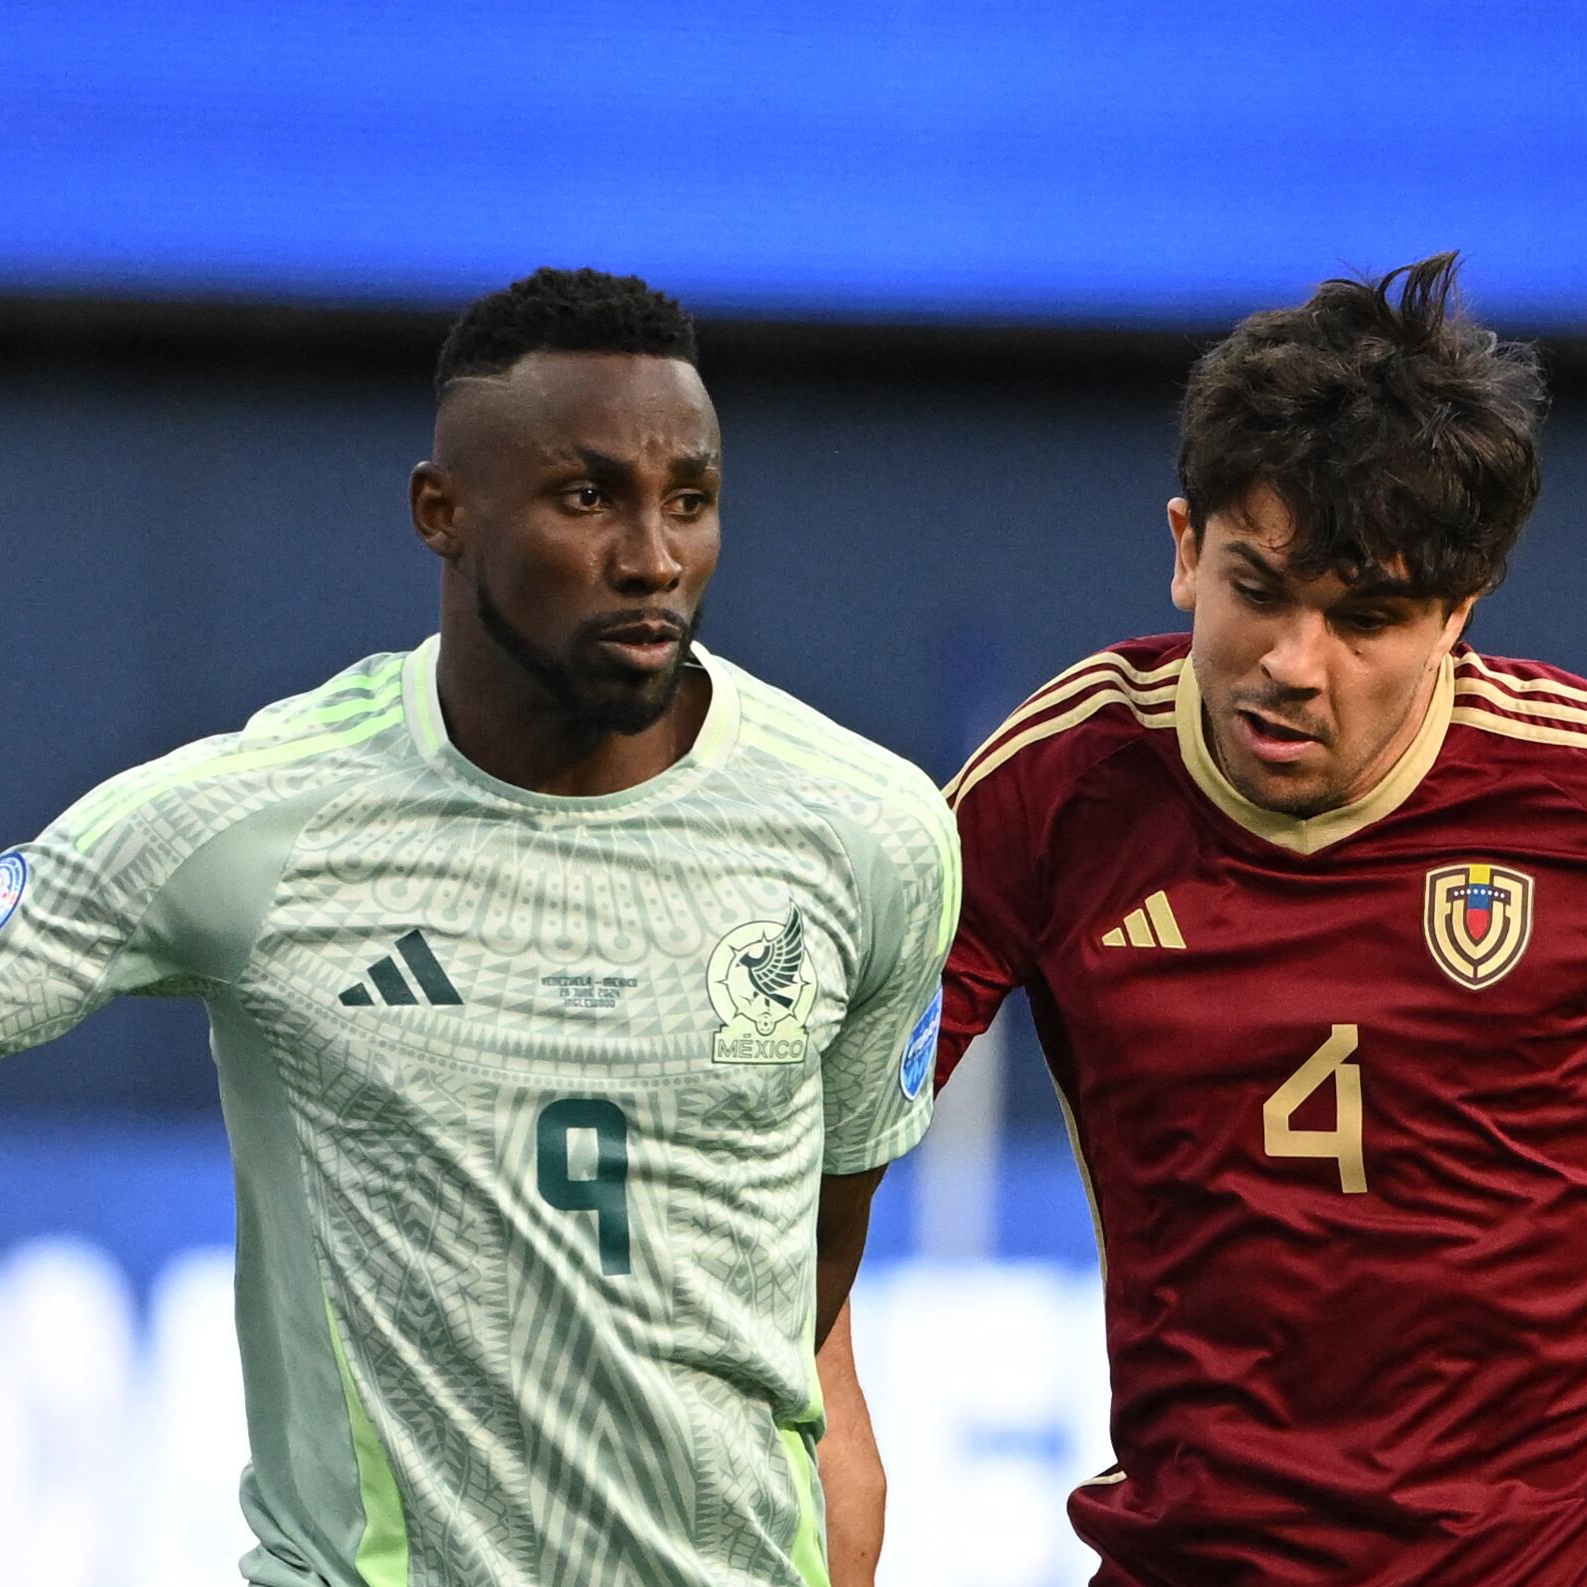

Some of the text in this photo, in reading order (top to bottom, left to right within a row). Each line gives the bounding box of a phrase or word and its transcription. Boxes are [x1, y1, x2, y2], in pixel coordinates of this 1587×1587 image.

[716, 1032, 804, 1060] MÉXICO
[1263, 1023, 1367, 1194] 4
[535, 1098, 631, 1276] 9
